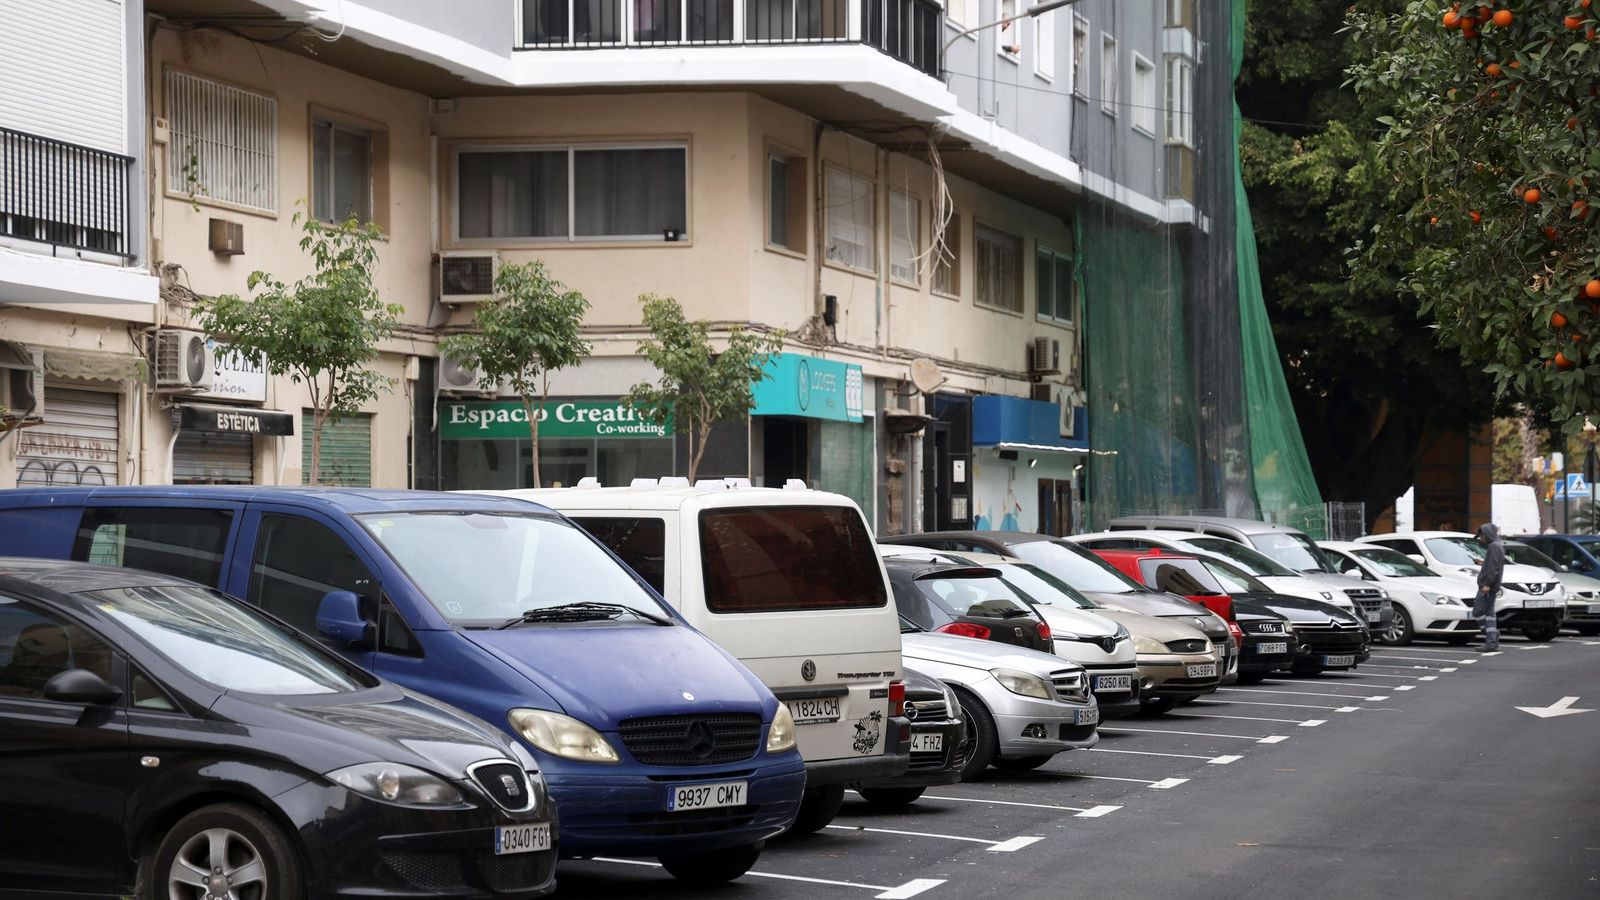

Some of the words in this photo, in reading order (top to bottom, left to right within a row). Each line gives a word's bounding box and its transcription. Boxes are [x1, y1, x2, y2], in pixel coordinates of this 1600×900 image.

[212, 379, 247, 393] ssion
[217, 411, 260, 432] ESTÉTICA
[449, 404, 548, 429] Espacio
[555, 403, 664, 423] Creativ
[596, 422, 665, 436] Co-working
[1100, 677, 1116, 688] 6250
[796, 700, 822, 718] 1824
[824, 699, 838, 716] CH
[924, 735, 941, 750] FHZ
[678, 787, 711, 808] 9937
[717, 785, 742, 804] CMY
[504, 829, 530, 850] 0340
[532, 826, 549, 847] FGY
